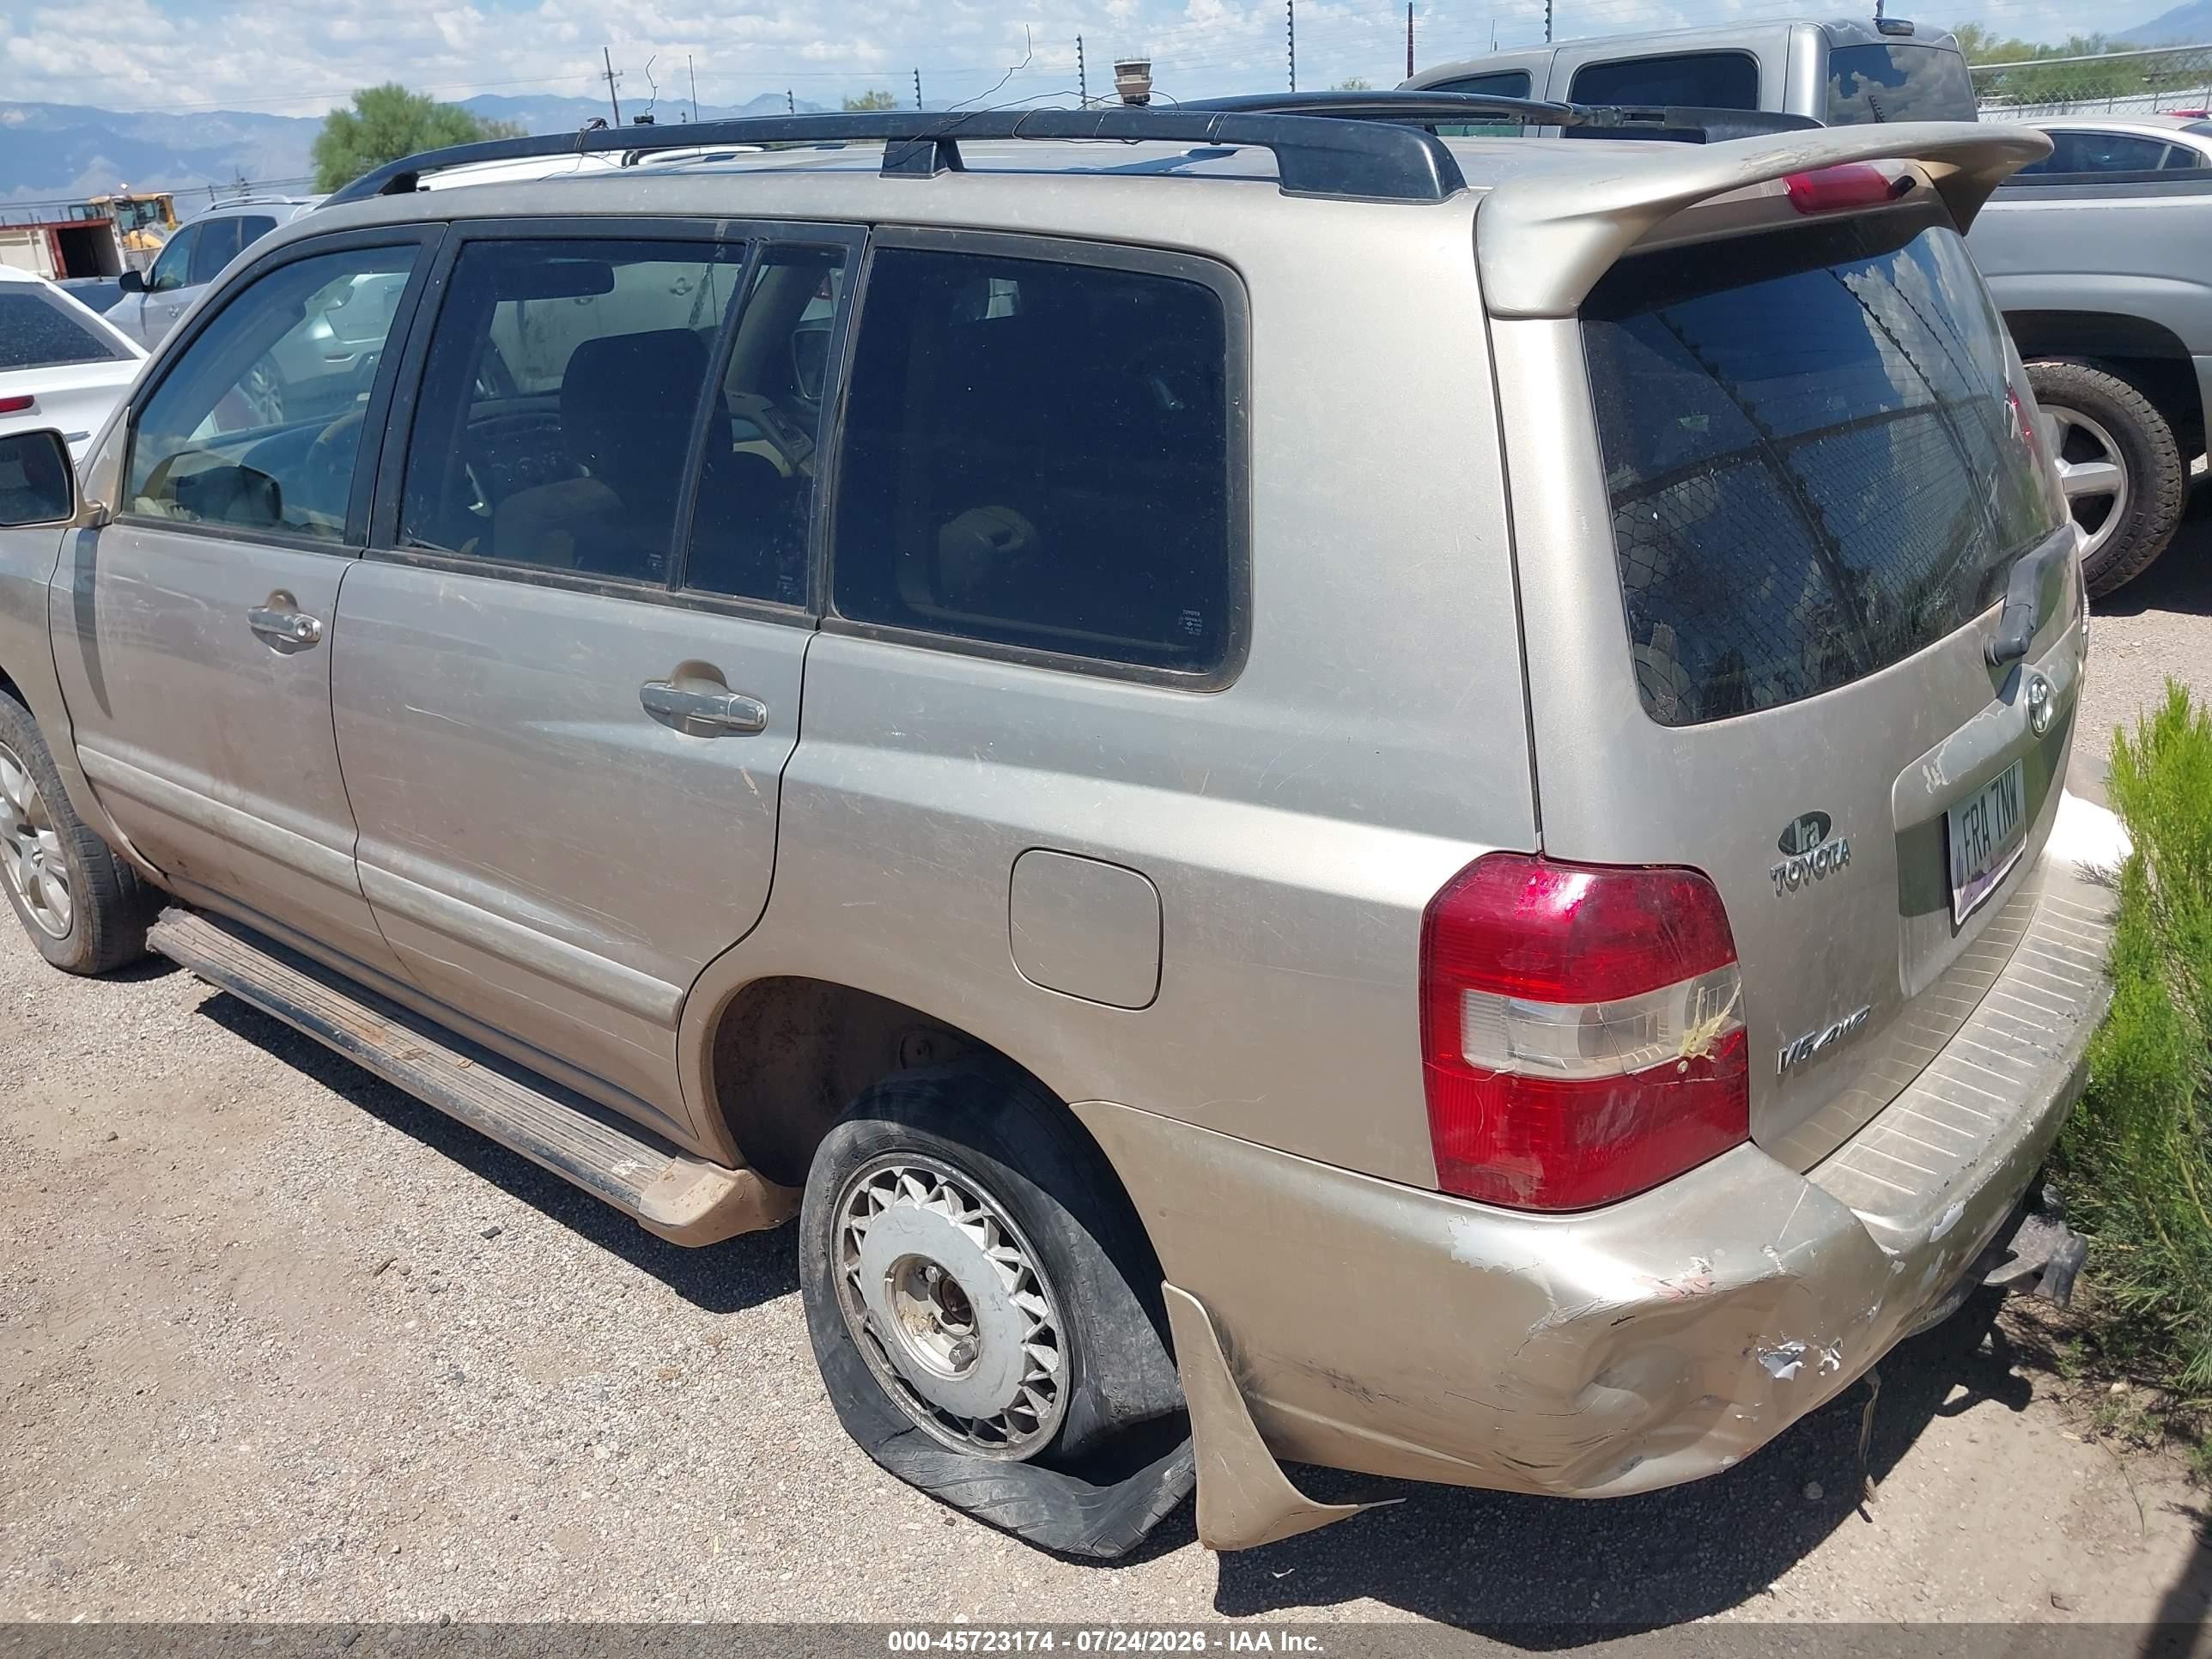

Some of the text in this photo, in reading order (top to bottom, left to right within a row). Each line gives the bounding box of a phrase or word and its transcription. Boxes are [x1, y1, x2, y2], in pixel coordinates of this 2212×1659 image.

[1794, 818, 1820, 854] Ira
[1962, 793, 1992, 875] FRA
[1770, 837, 1850, 895] TOYOTA
[1776, 1030, 1816, 1074] V6
